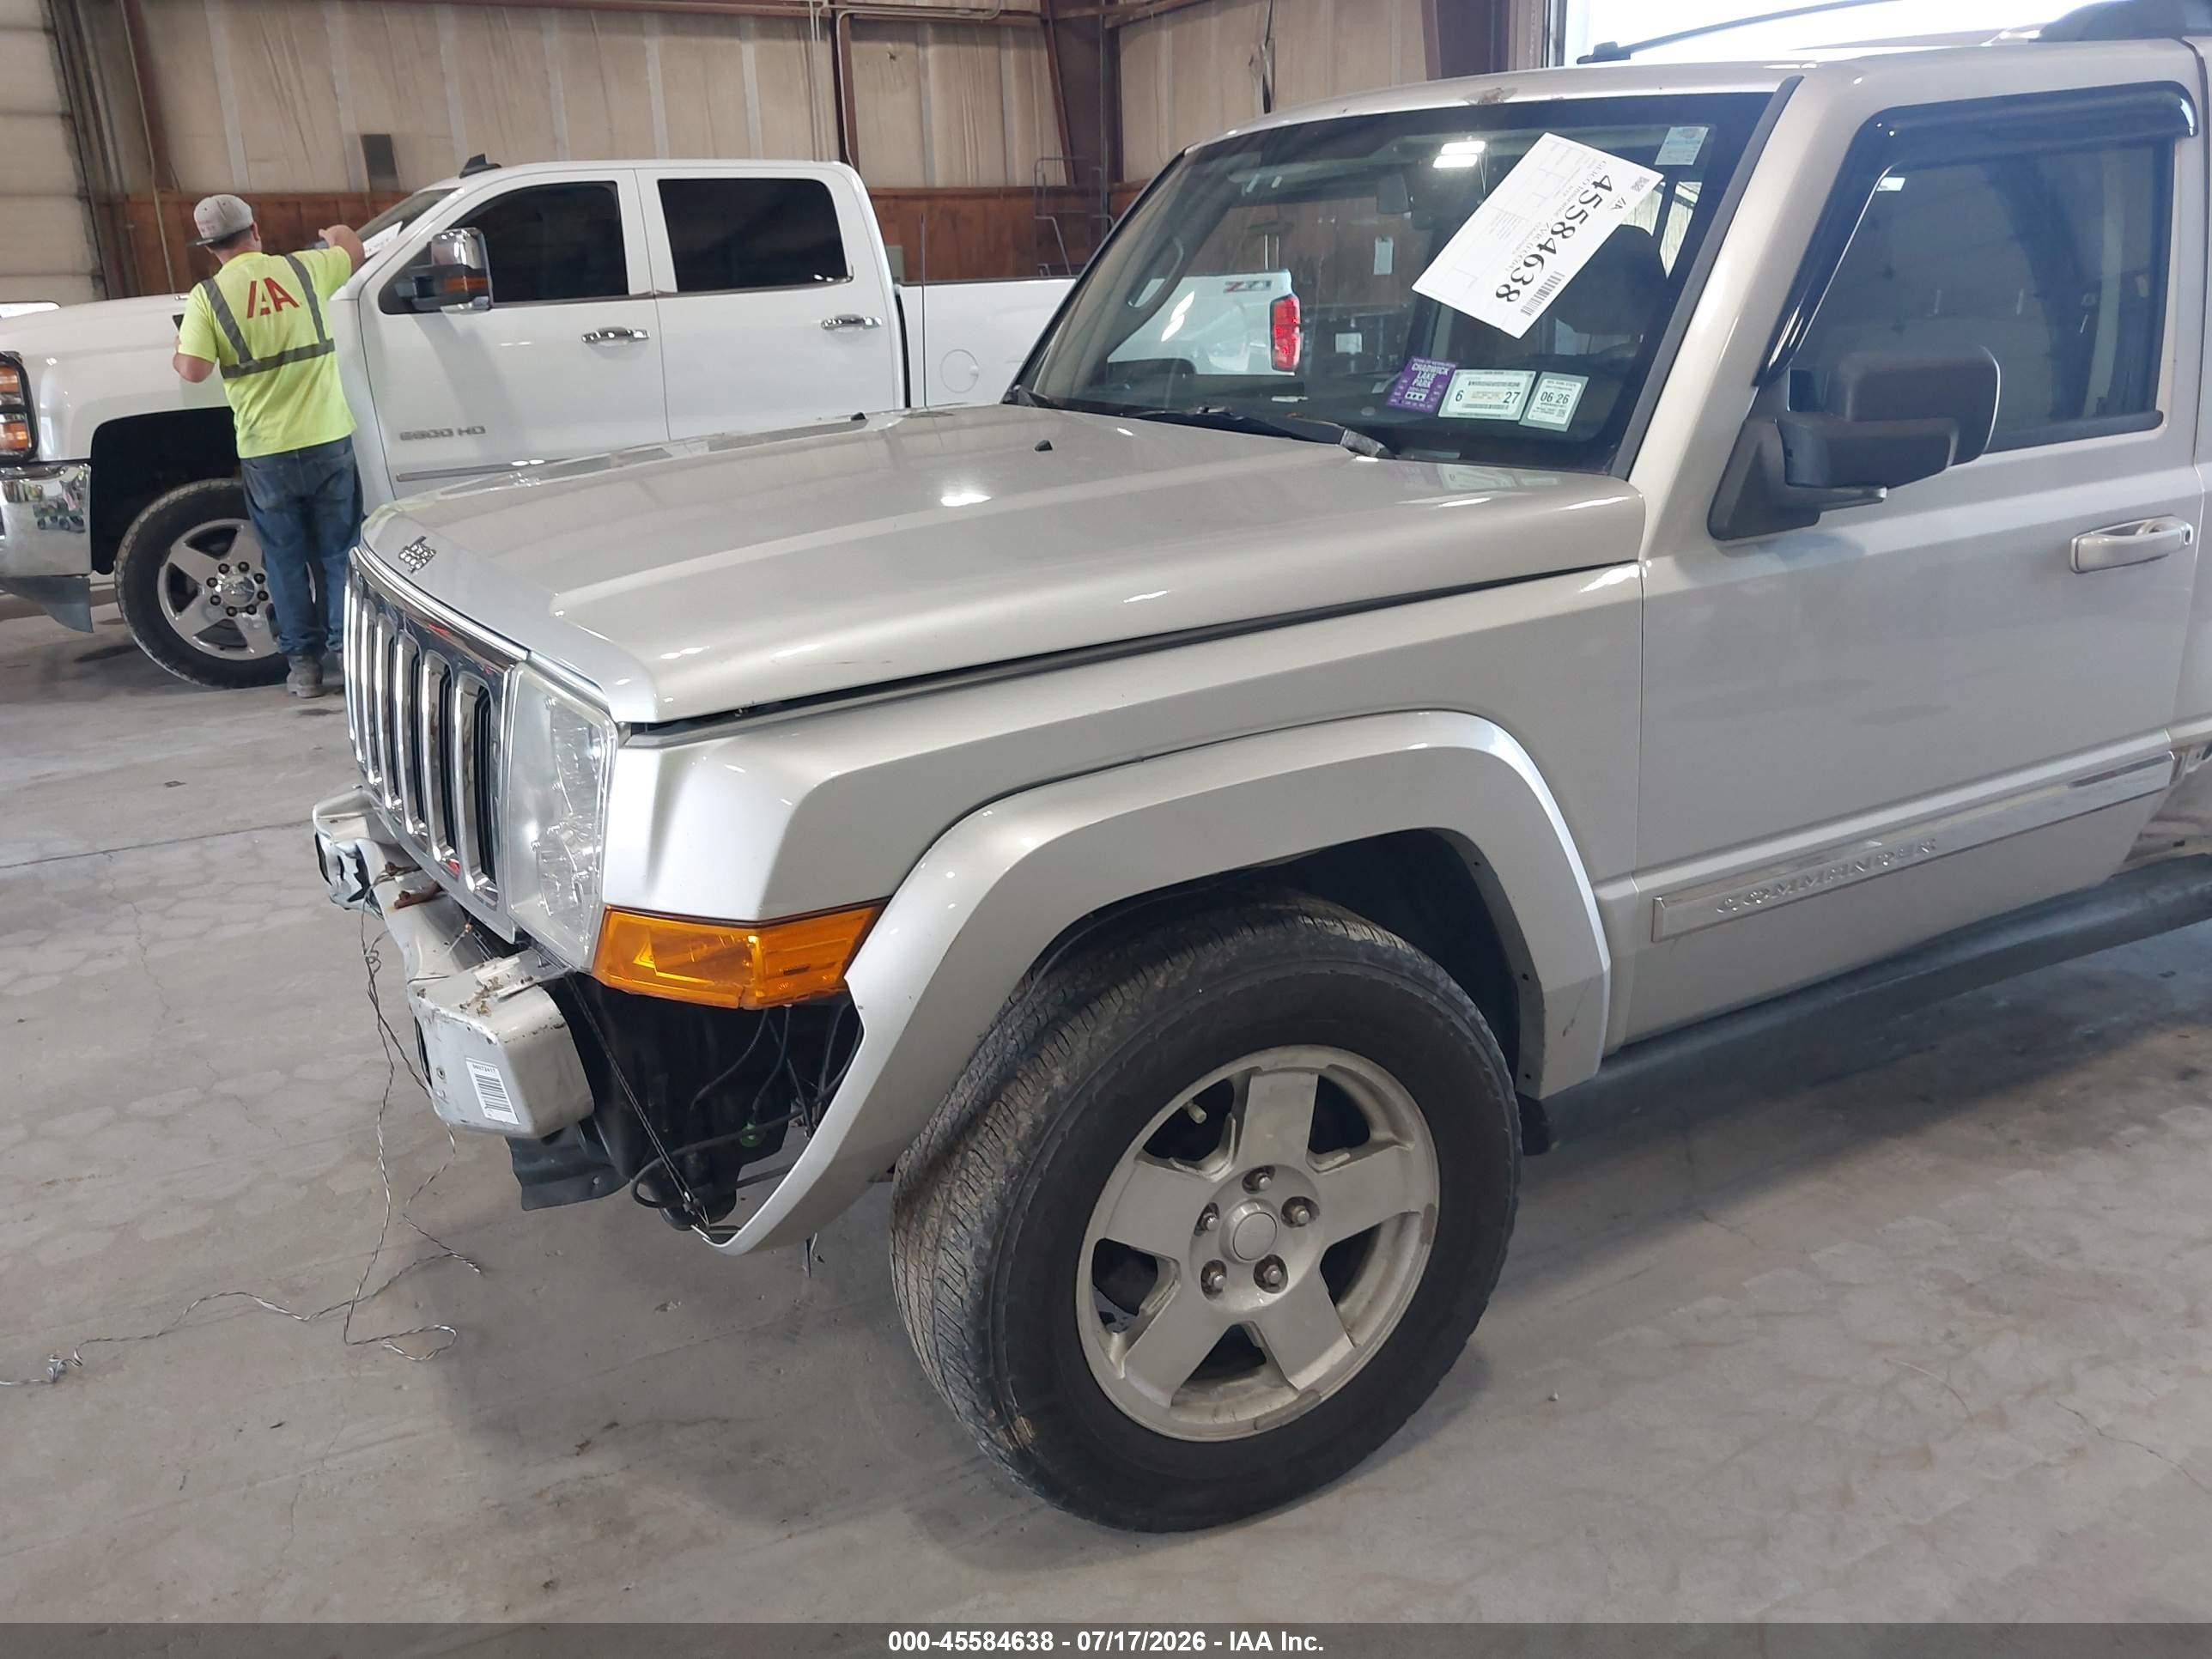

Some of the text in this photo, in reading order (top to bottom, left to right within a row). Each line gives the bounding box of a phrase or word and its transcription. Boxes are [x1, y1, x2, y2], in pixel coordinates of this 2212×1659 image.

[1495, 174, 1613, 302] 45584638
[1455, 389, 1521, 404] 6 27
[1540, 391, 1571, 404] 06 26
